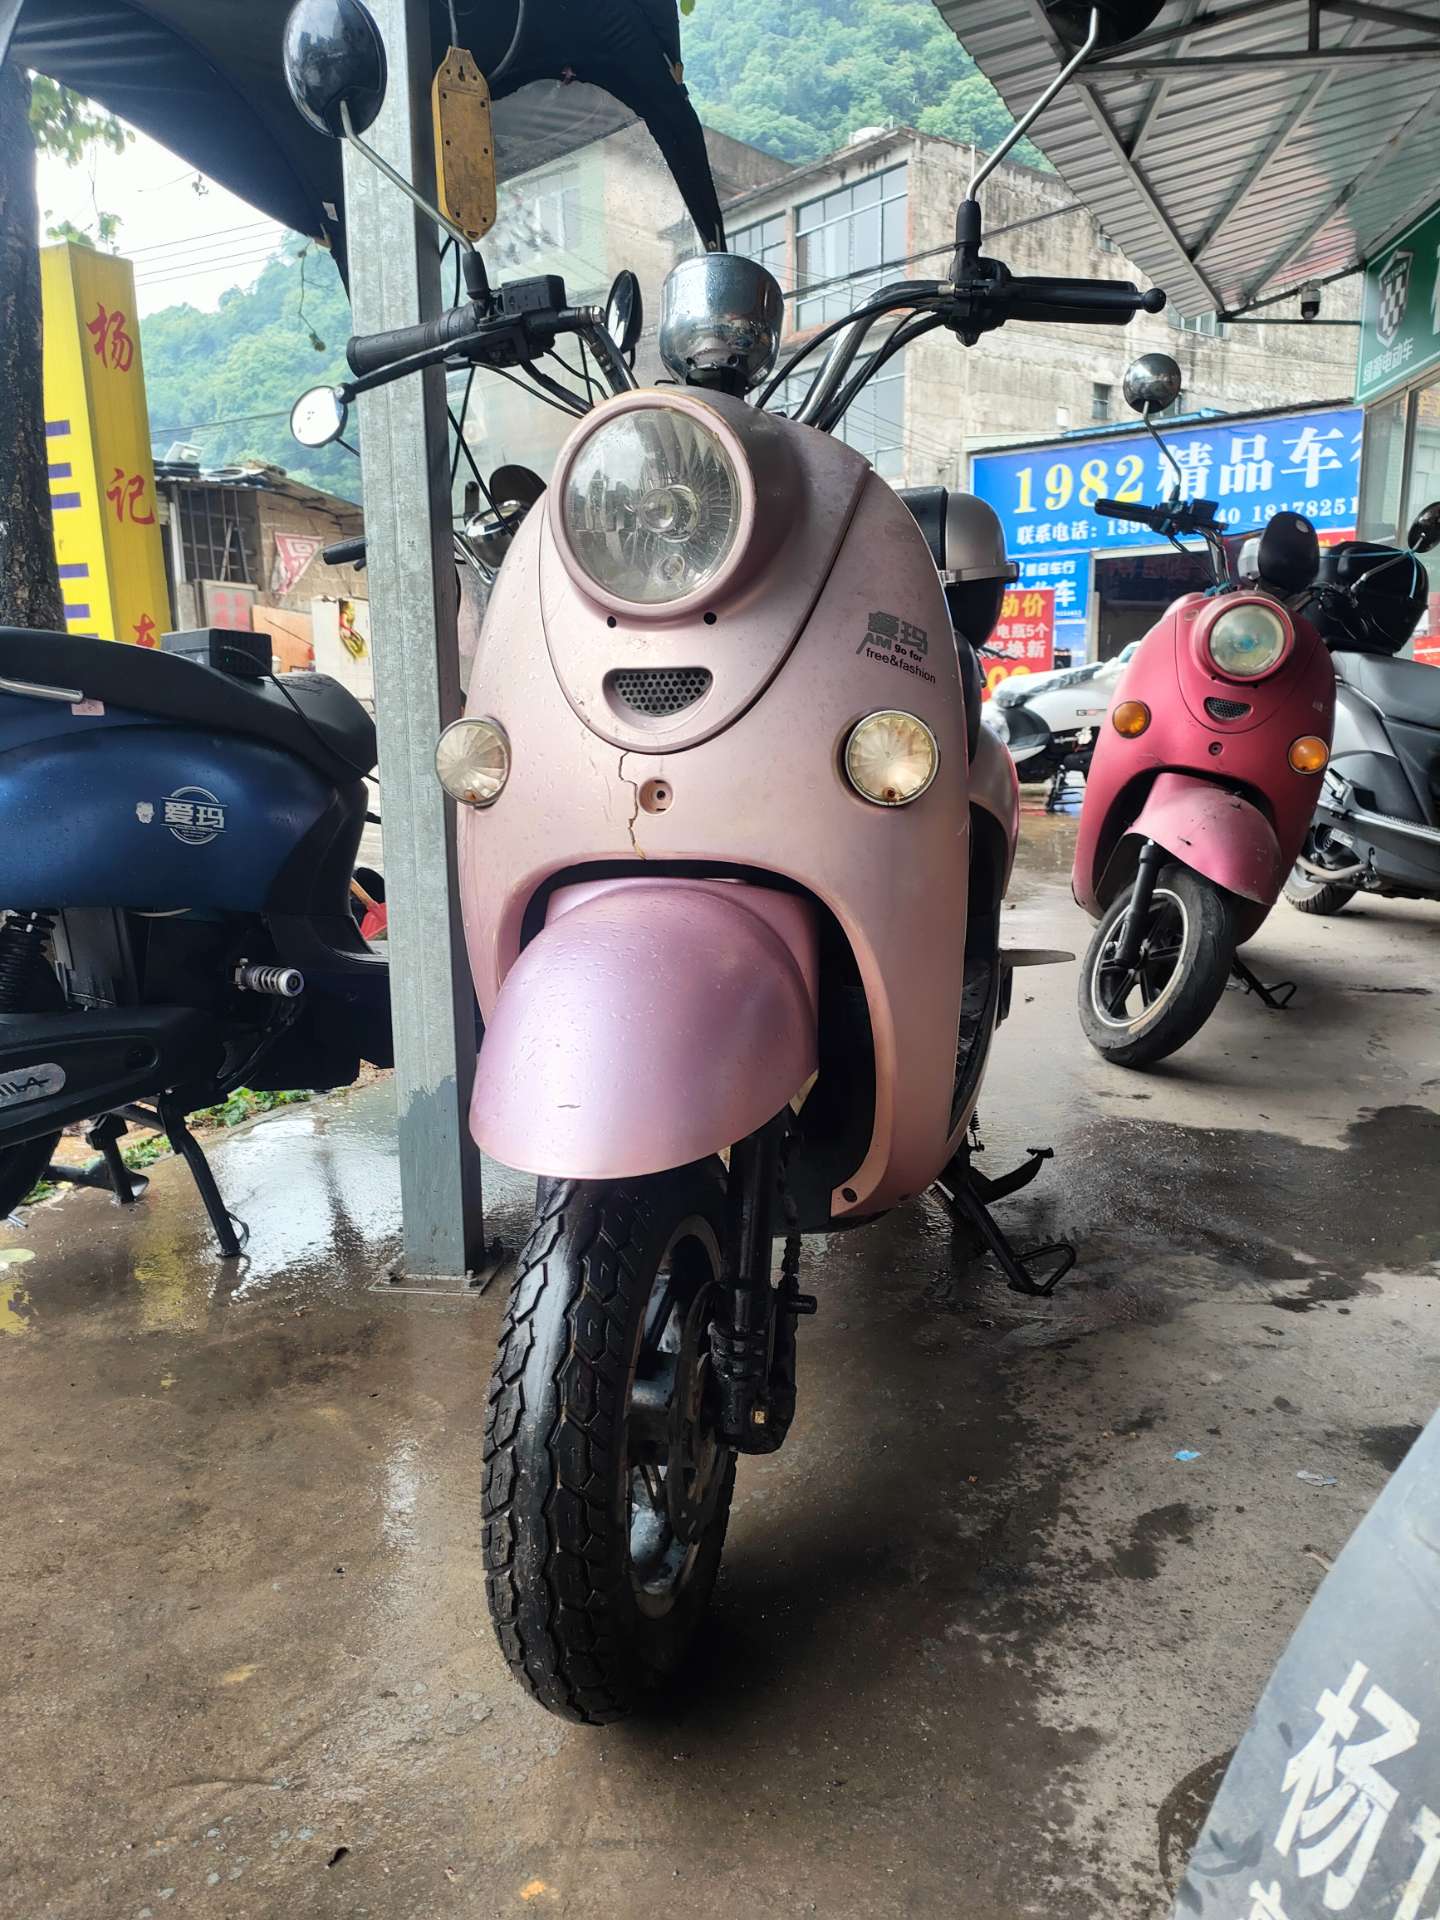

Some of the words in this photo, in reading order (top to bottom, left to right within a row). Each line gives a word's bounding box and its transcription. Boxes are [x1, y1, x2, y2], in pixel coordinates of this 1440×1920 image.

[1013, 427, 1361, 515] 1982精品车
[865, 647, 937, 685] free&fashion
[894, 643, 908, 656] go
[909, 649, 923, 663] for
[165, 801, 225, 829] 爱玛
